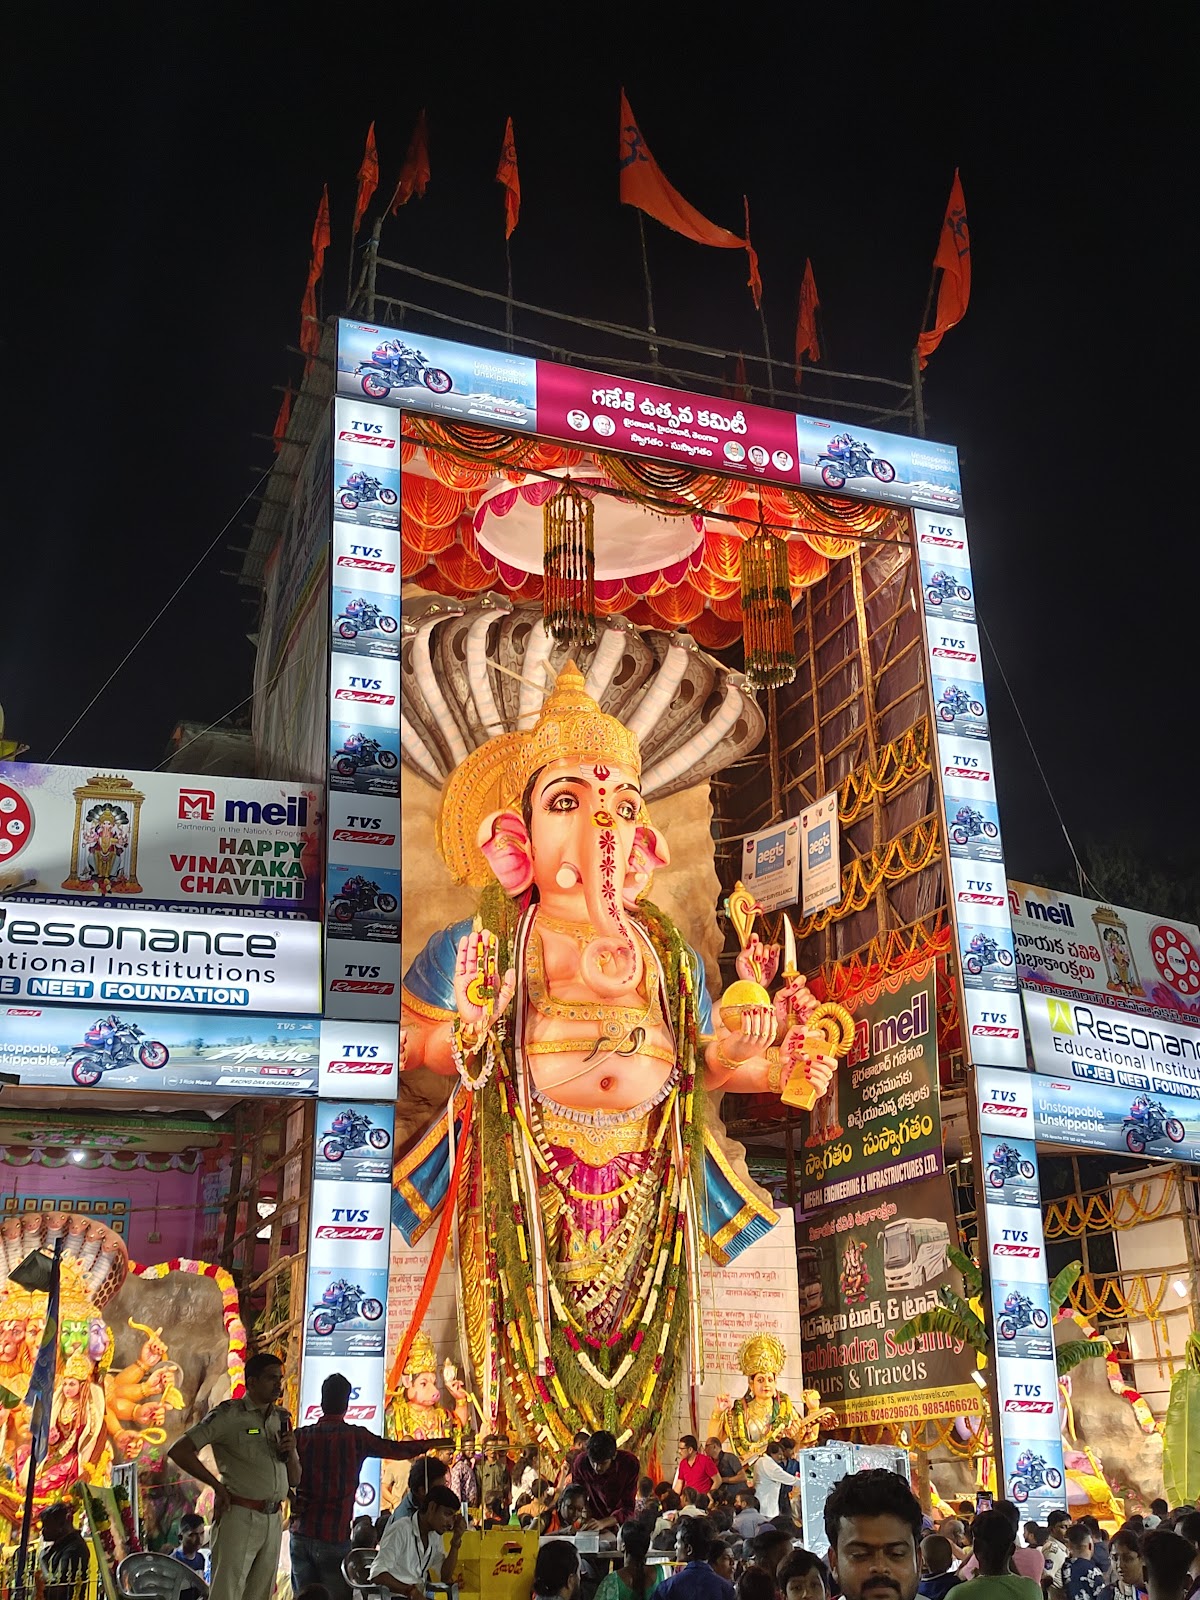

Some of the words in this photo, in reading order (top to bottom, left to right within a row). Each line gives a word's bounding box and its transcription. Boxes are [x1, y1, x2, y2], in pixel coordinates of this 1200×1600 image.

[591, 387, 636, 412] గణేశ్
[638, 397, 694, 428] ఉత్సవ
[697, 410, 747, 435] కమిటీ
[352, 421, 383, 434] TVS
[340, 434, 394, 449] Racing
[630, 433, 664, 448] స్వాగతం
[670, 441, 713, 457] సుస్వాగతం
[928, 524, 953, 537] TVS
[350, 545, 382, 558] TVS
[339, 558, 393, 573] Racing
[940, 637, 965, 649] TVS
[349, 676, 381, 690] TVS
[336, 690, 394, 705] Racing
[952, 755, 979, 767] TVS
[225, 796, 307, 826] meil
[177, 823, 216, 833] Partnering
[243, 827, 272, 836] Nation's
[347, 816, 381, 830] TVS
[334, 831, 394, 845] Racing
[809, 831, 831, 855] aegis
[219, 837, 306, 859] HAPPY
[757, 842, 785, 864] aegis
[170, 855, 306, 880] VINAYAKA
[180, 875, 304, 899] CHAVITHI
[966, 880, 992, 892] TVS
[1025, 900, 1075, 928] meil
[1067, 941, 1101, 962] చవితి
[108, 956, 276, 984] Institutions
[345, 965, 380, 978] TVS
[31, 979, 90, 997] NEET
[105, 983, 245, 1004] FOUNDATION
[331, 980, 394, 994] Racing
[277, 1022, 296, 1031] TVS
[873, 990, 929, 1056] meil
[981, 1012, 1007, 1024] TVS
[1074, 1006, 1200, 1061] Resonan
[205, 1043, 314, 1065] Apache
[342, 1045, 379, 1058] TVS
[1053, 1037, 1147, 1070] Educational
[220, 1065, 257, 1074] RTR
[328, 1062, 393, 1075] Racing
[851, 1054, 892, 1090] ఖైరతాబాద్
[1074, 1063, 1113, 1082] IIT-JEE
[1119, 1072, 1148, 1089] NEET
[862, 1070, 913, 1103] దర్శనమునకు
[991, 1090, 1017, 1102] TVS
[847, 1097, 898, 1130] విచ్చేయుచున్న
[897, 1084, 930, 1112] భక్తులకు
[1038, 1099, 1105, 1119] Unstoppable.
[1039, 1112, 1106, 1133] Unskippable.
[805, 1143, 853, 1181] స్వాగతం
[862, 1114, 934, 1157] సుస్వాగతం
[803, 1188, 823, 1211] MEGHA
[823, 1176, 861, 1205] ENGINEERING
[860, 1177, 867, 1193] &
[866, 1157, 924, 1192] INFRASTRUCTURES
[924, 1153, 939, 1176] LTD.
[332, 1209, 369, 1222] TVS
[836, 1213, 855, 1233] చవితి
[854, 1201, 898, 1228] శుభాకాంక్షలు
[317, 1227, 383, 1240] Racing
[1002, 1229, 1029, 1242] TVS
[887, 1297, 900, 1321] &
[848, 1368, 862, 1395] &
[864, 1358, 928, 1392] Travels
[1013, 1384, 1041, 1397] TVS
[851, 1398, 878, 1411] Hyderabad
[922, 1397, 979, 1416] 9885466626
